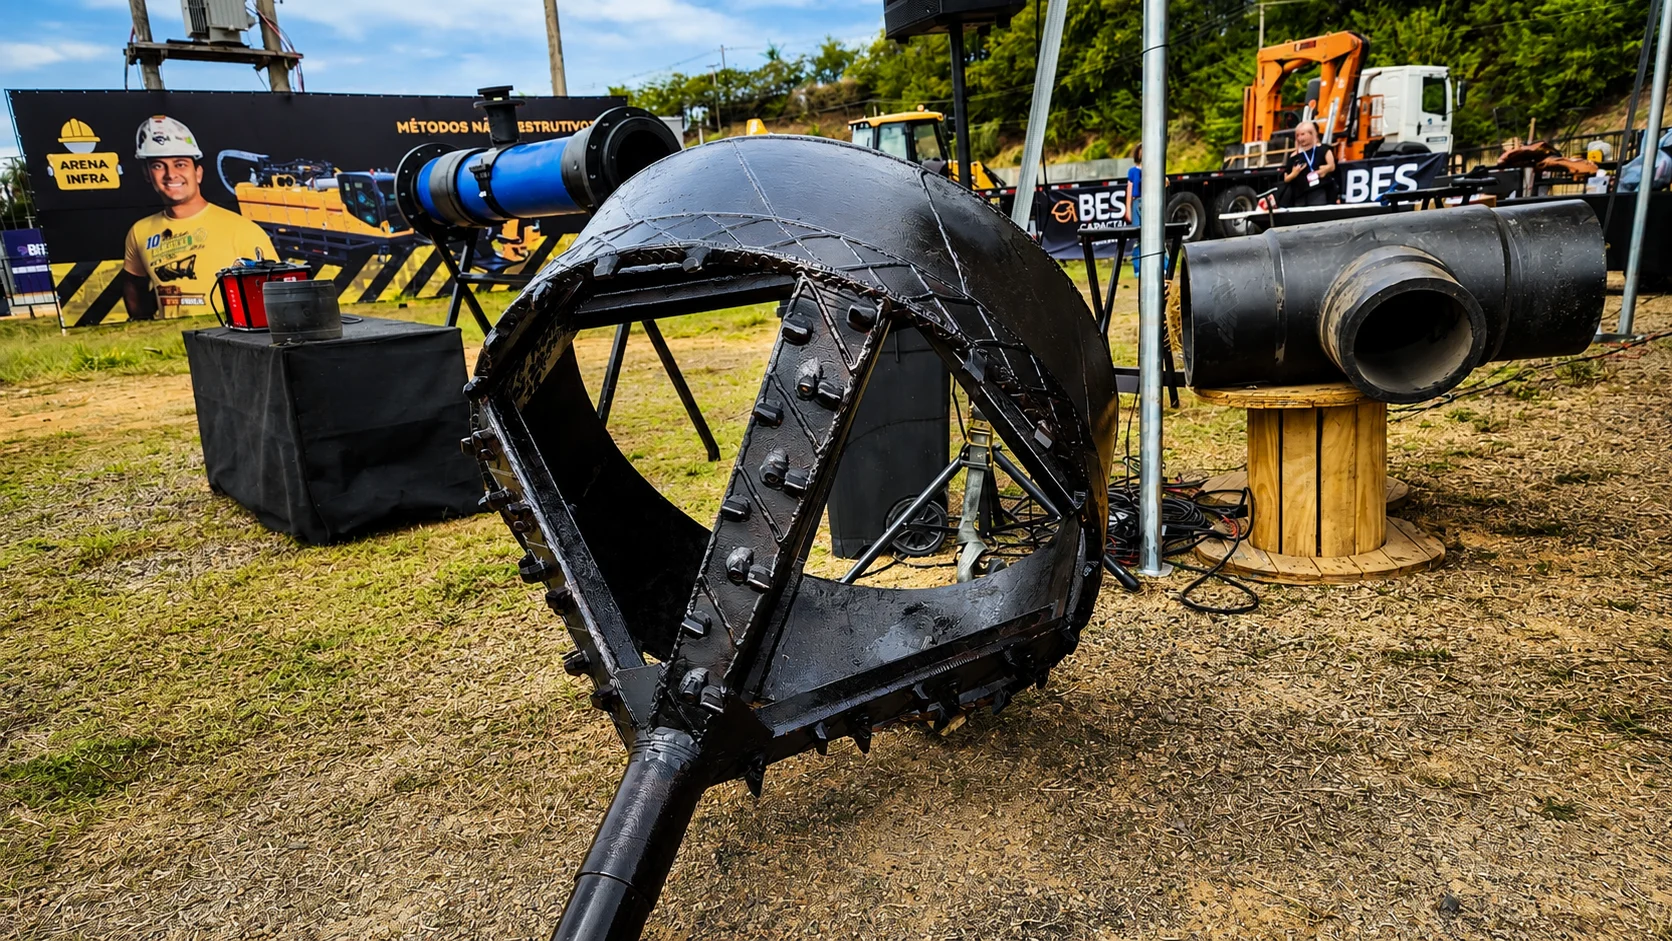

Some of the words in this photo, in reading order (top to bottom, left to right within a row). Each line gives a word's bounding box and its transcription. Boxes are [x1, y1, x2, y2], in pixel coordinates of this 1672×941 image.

[397, 118, 469, 134] MÉTODOS
[472, 117, 491, 133] NÃ
[517, 120, 595, 133] ESTRUTIVO
[60, 159, 110, 171] ARENA
[66, 173, 110, 185] INFRA
[1345, 163, 1418, 204] BES
[1078, 190, 1127, 222] BES
[146, 233, 161, 250] 10
